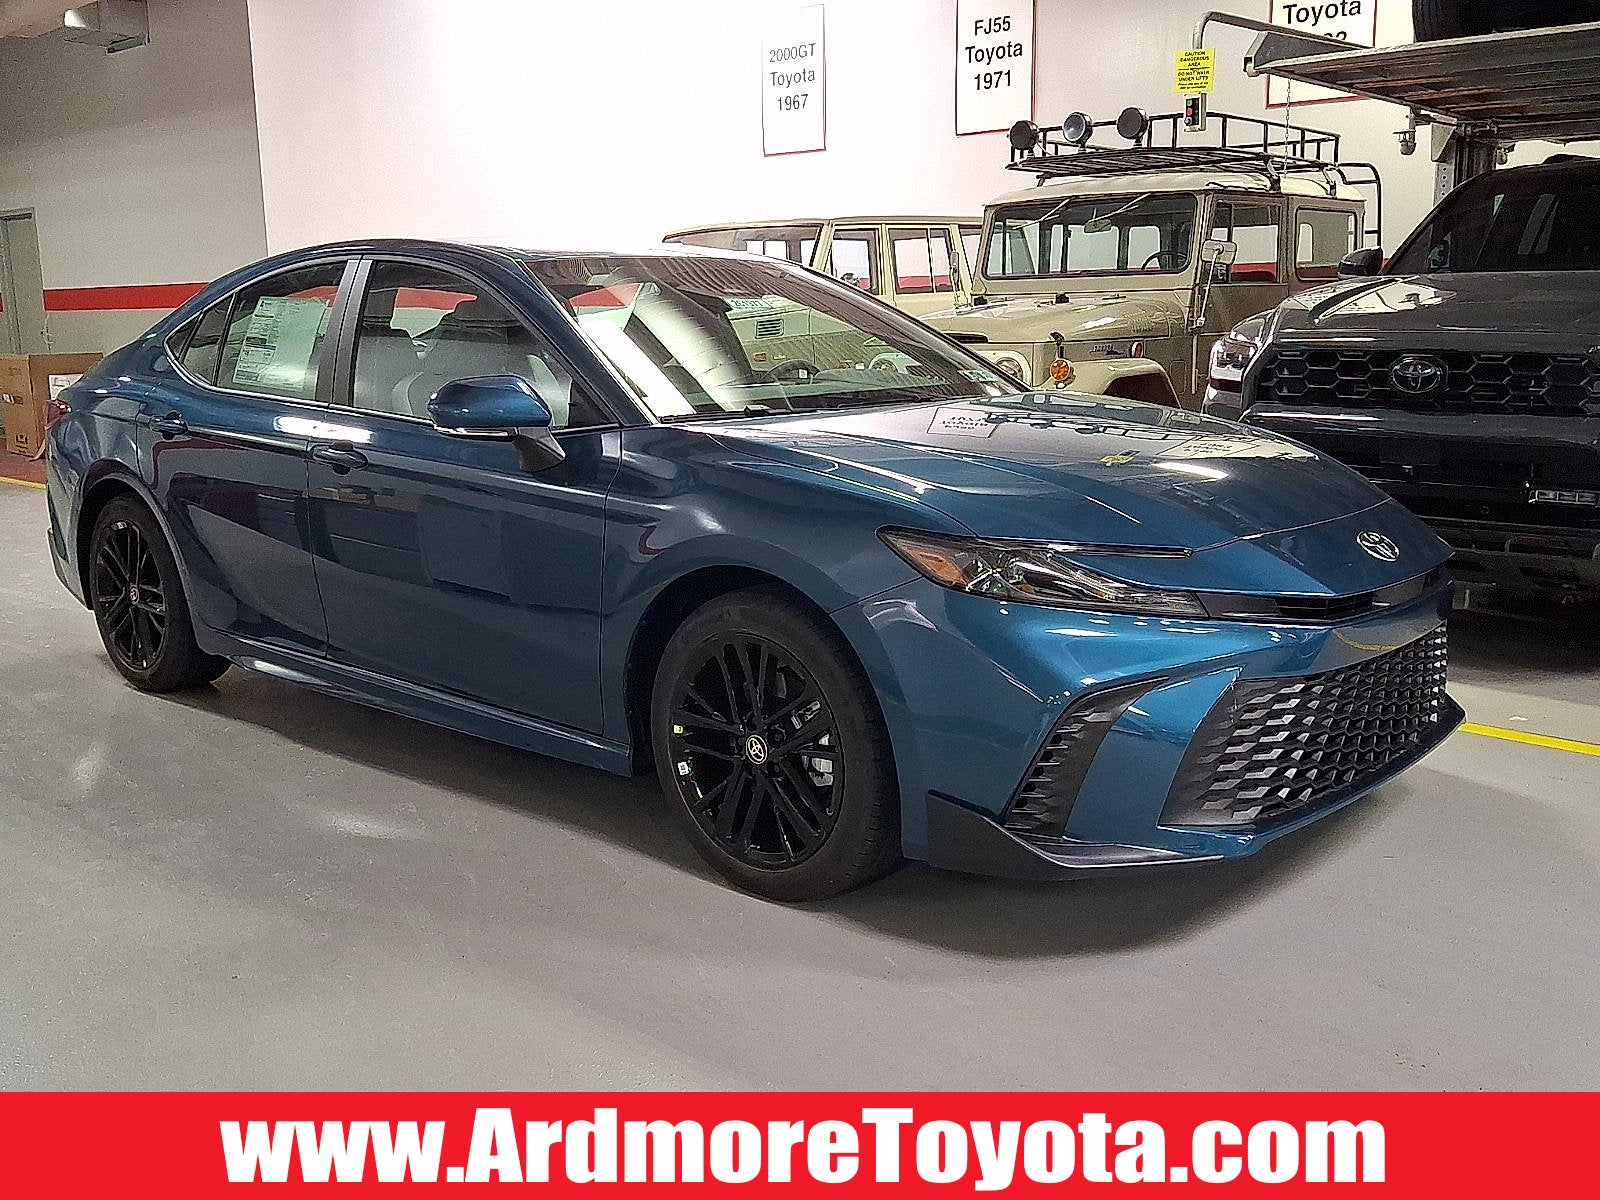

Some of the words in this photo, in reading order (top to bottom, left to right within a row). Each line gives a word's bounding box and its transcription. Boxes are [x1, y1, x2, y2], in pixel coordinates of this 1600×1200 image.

[1282, 0, 1362, 27] Toyota
[974, 15, 1011, 36] FJ55
[769, 42, 817, 63] 2000GT
[964, 40, 1023, 66] Toyota
[769, 67, 815, 89] Toyota
[974, 69, 1011, 91] 1971
[777, 93, 809, 112] 1967
